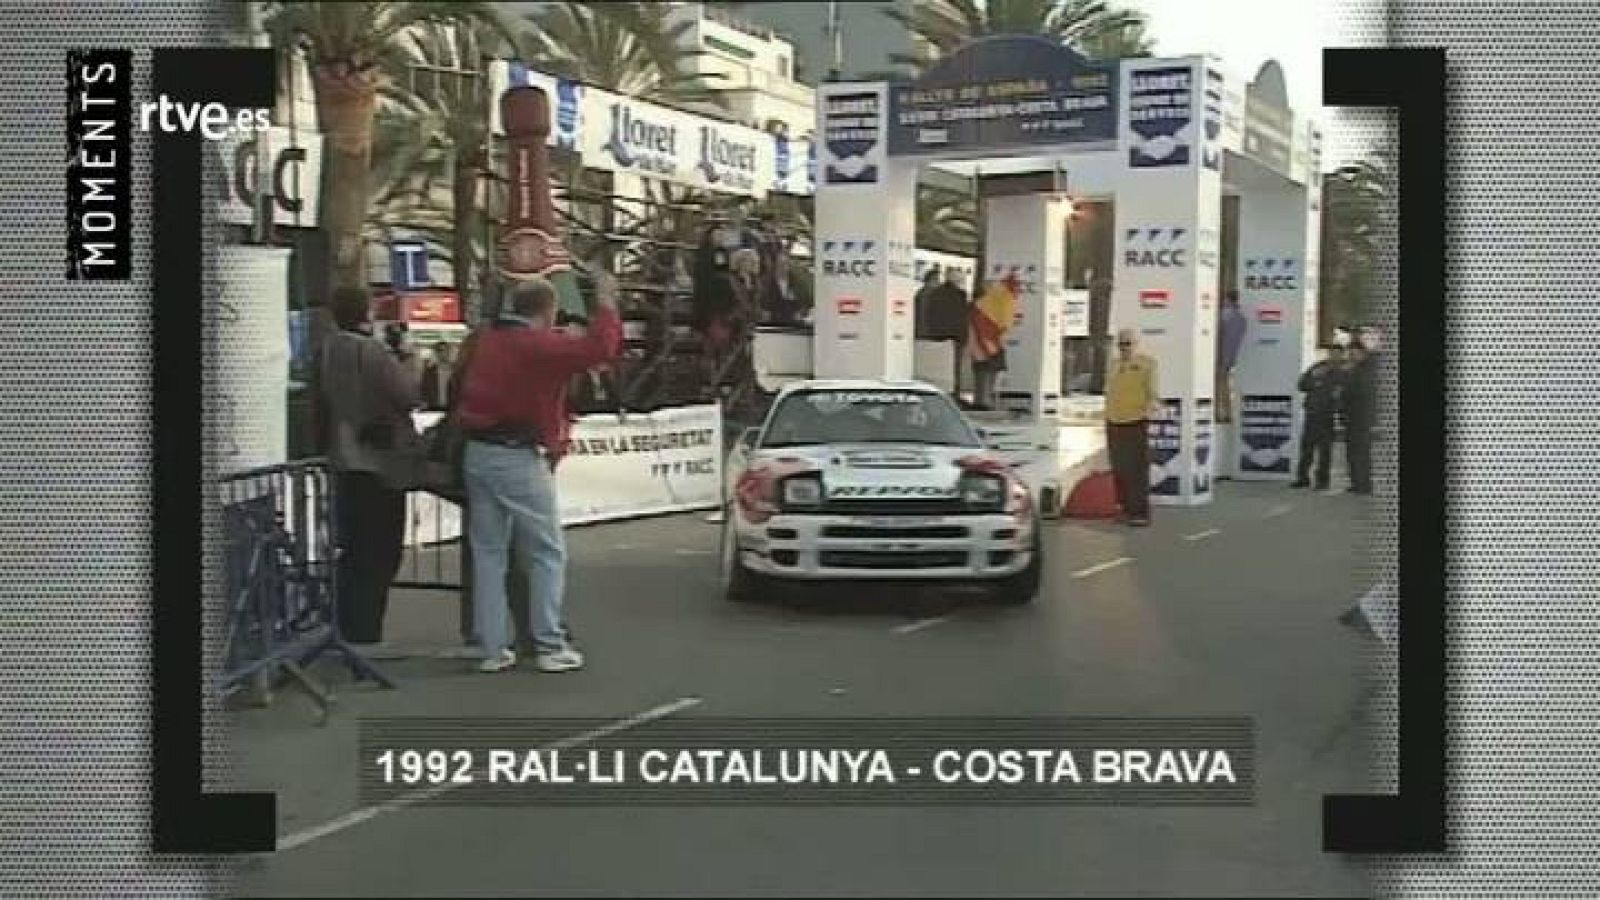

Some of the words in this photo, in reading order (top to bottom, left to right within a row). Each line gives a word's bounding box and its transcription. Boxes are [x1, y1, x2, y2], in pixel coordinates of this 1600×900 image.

[1124, 249, 1186, 267] RACC
[823, 259, 876, 277] RACC
[1245, 274, 1297, 290] RACC
